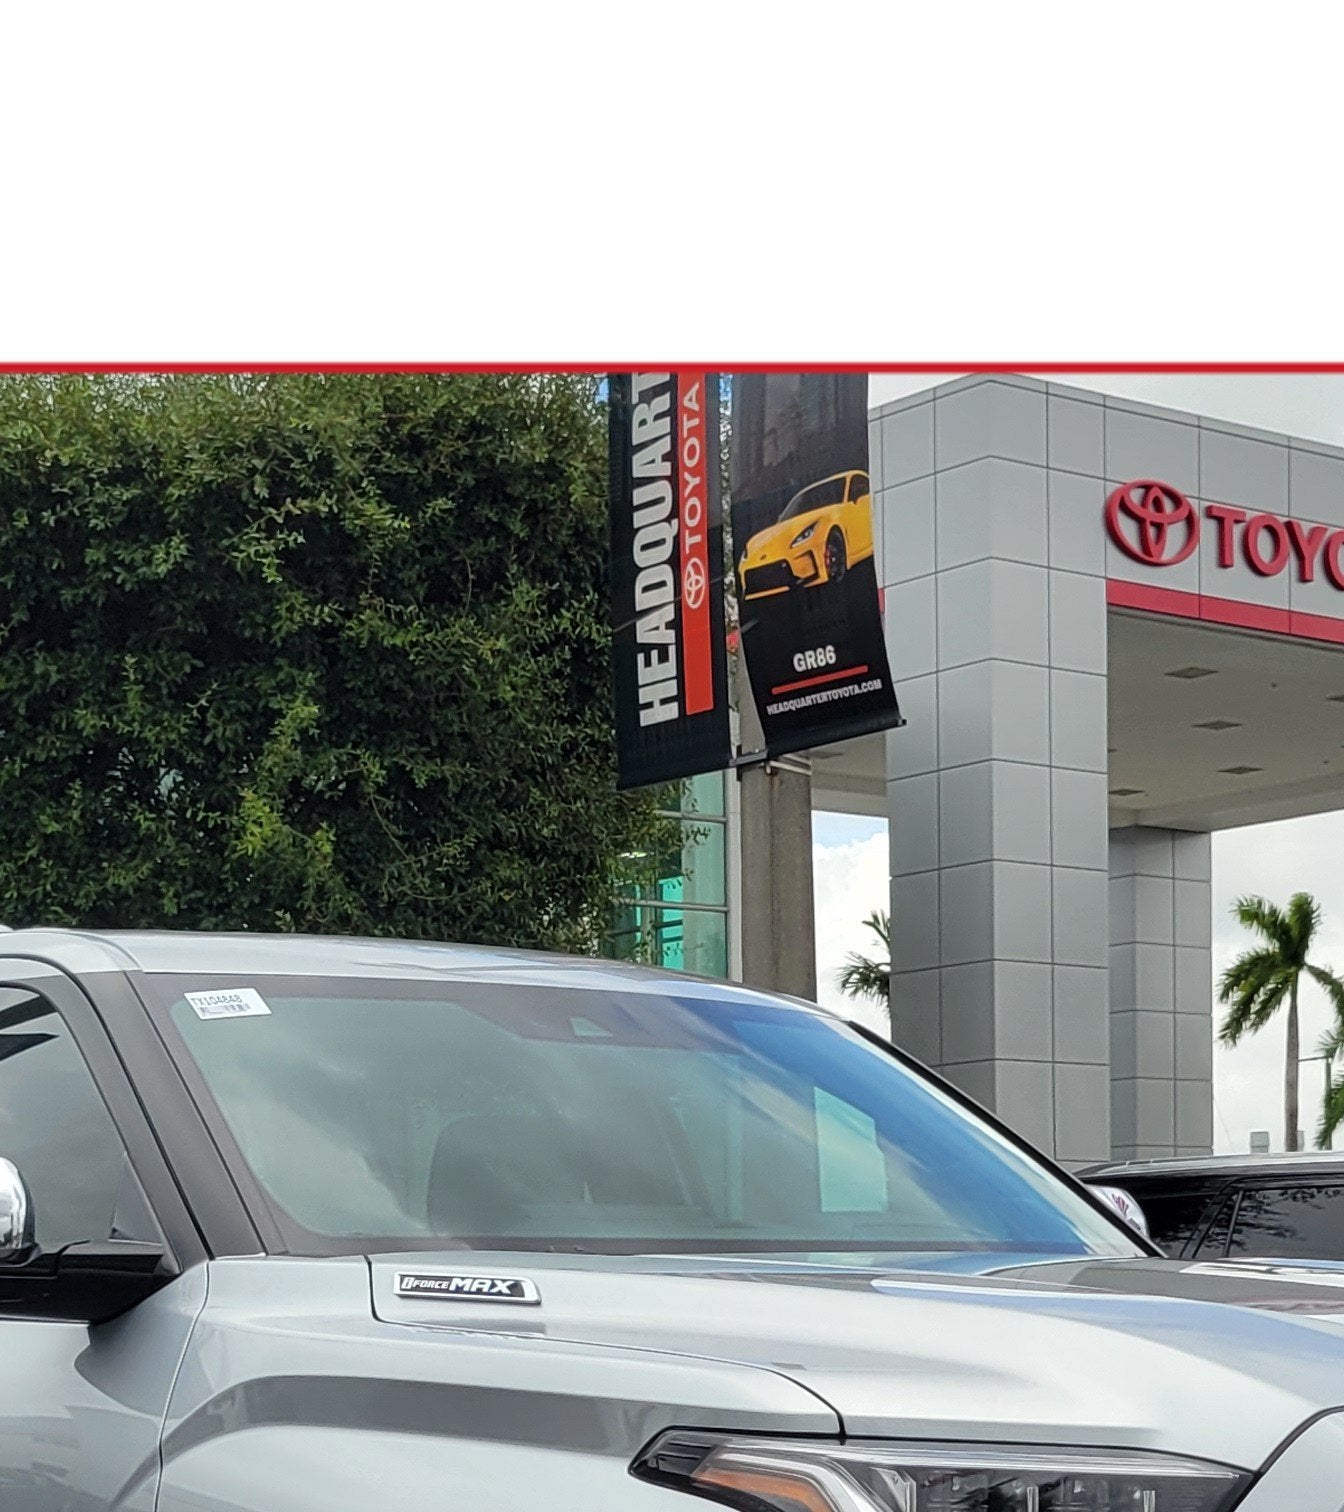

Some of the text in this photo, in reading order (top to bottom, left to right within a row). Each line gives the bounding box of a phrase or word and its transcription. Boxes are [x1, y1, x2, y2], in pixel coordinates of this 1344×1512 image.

[683, 381, 703, 554] TOYOTA
[792, 644, 837, 673] GR86
[766, 678, 883, 716] HEADQUARTERTOYOTA.COM
[449, 1277, 516, 1295] MAX
